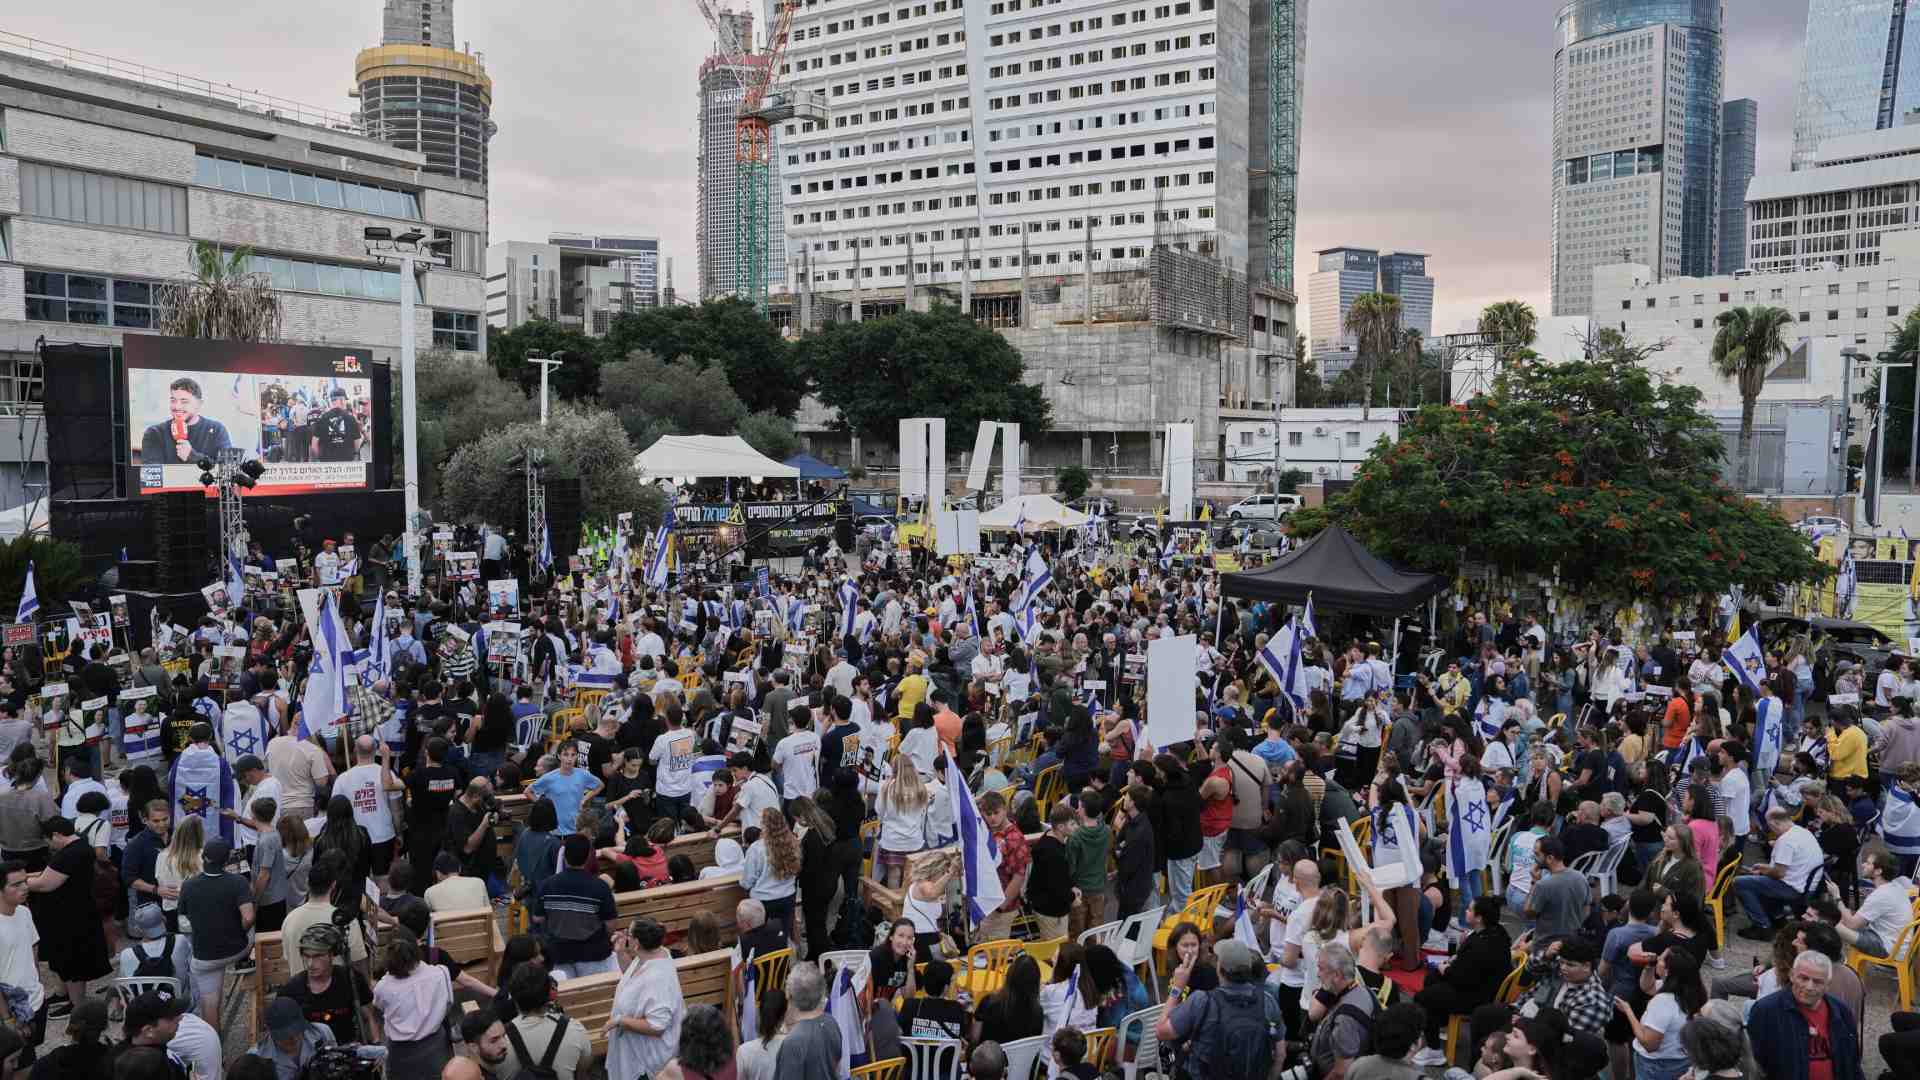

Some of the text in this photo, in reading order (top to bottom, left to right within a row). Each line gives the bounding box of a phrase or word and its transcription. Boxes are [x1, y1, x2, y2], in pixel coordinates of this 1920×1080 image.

[703, 506, 731, 522] ישראל
[747, 505, 780, 519] החטופים
[781, 504, 793, 518] את
[813, 503, 829, 516] העם
